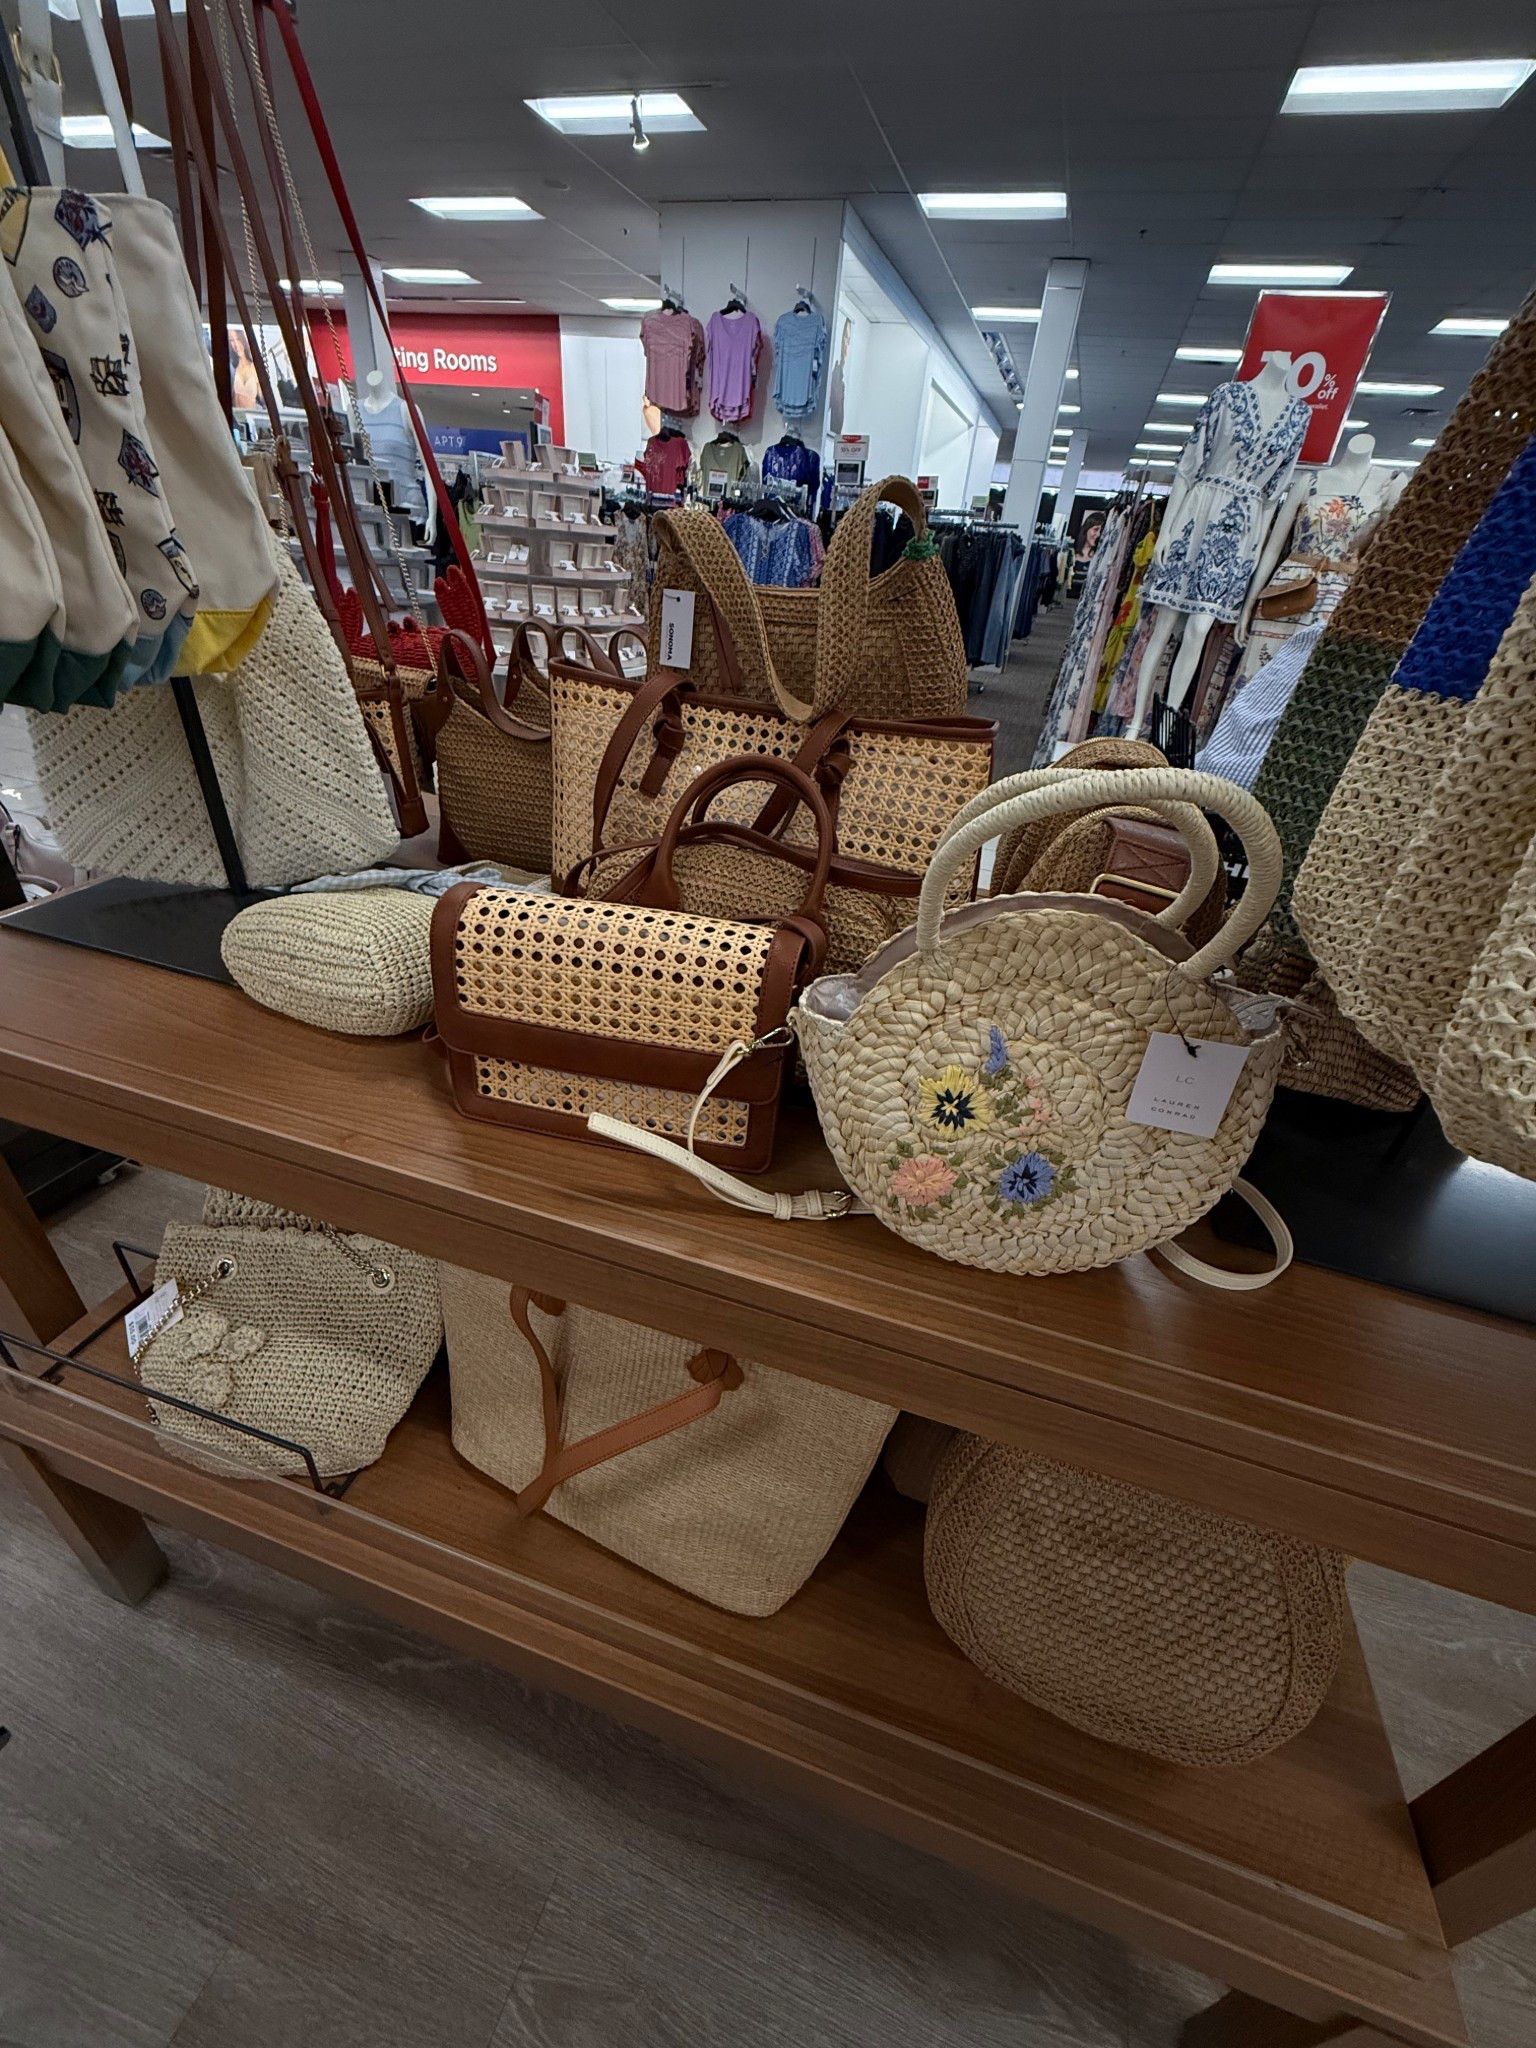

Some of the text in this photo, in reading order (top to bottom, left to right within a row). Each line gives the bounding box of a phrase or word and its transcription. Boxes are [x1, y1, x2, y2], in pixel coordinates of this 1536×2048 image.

[393, 346, 498, 373] ting Rooms
[1317, 387, 1339, 400] off
[667, 622, 675, 661] SONOMA
[1175, 1074, 1195, 1085] LC
[1153, 1096, 1200, 1110] LAUREN
[1151, 1106, 1196, 1120] CONRAD
